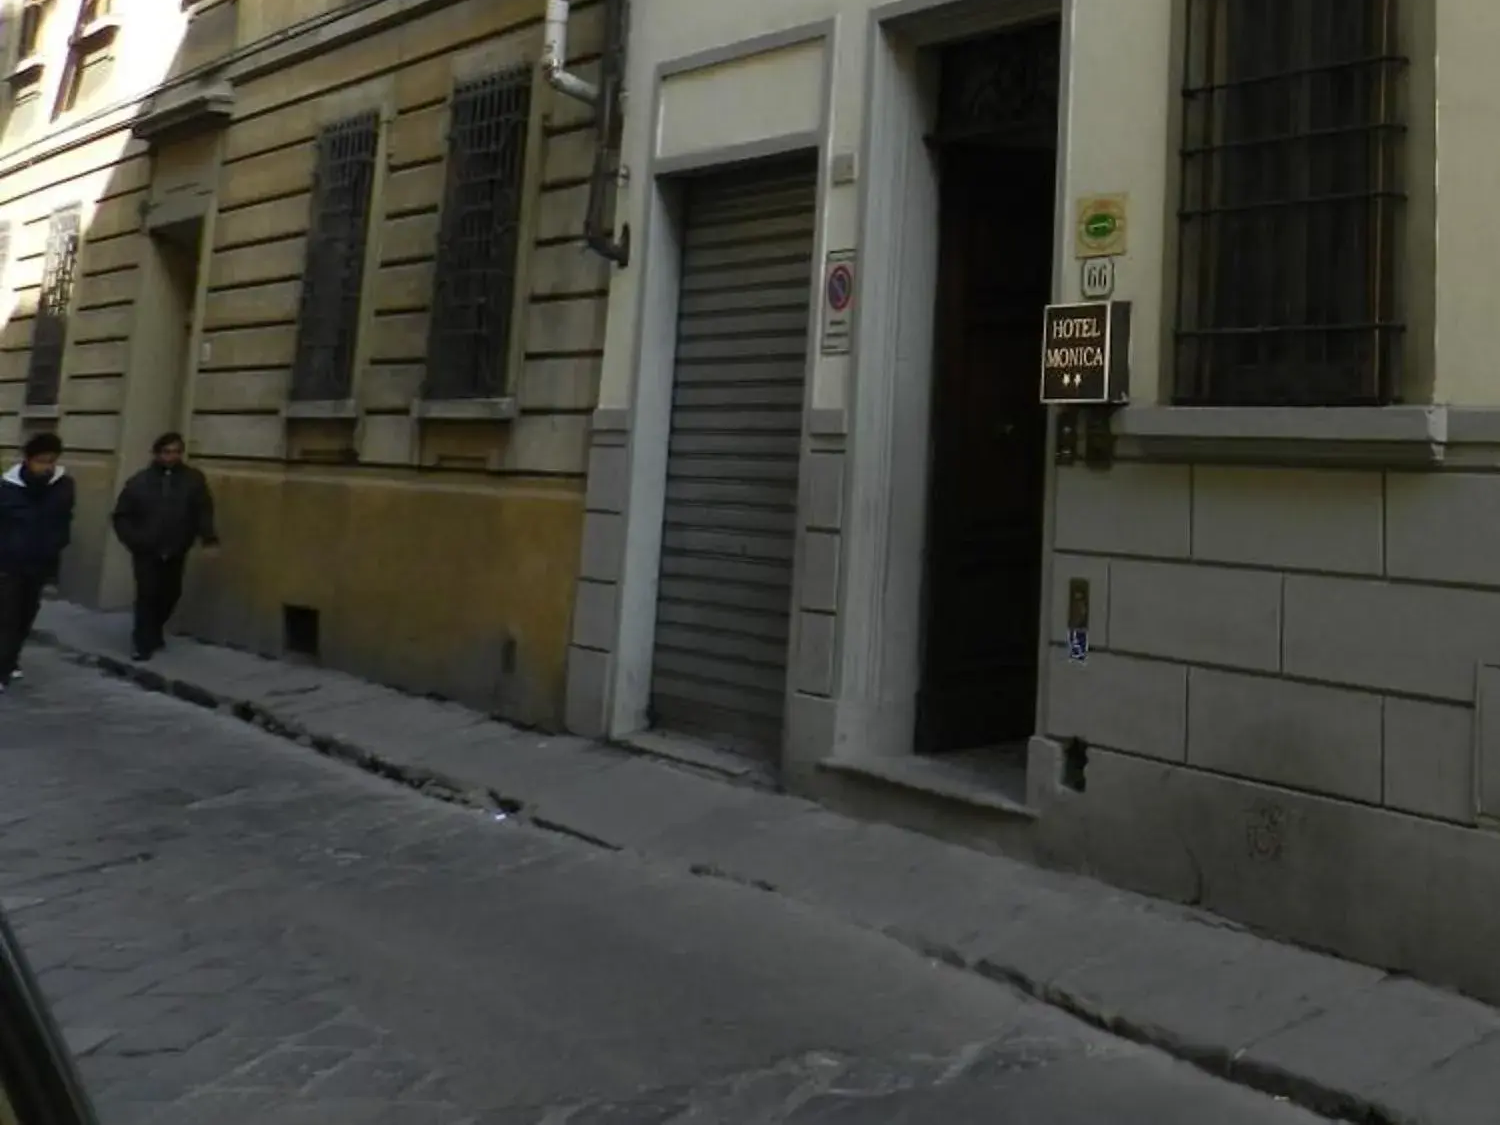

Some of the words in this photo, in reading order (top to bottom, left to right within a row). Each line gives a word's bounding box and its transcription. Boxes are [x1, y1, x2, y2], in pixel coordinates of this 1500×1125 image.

[1087, 264, 1107, 288] 66
[1053, 317, 1101, 339] HOTEL
[1045, 346, 1103, 368] MONICA
